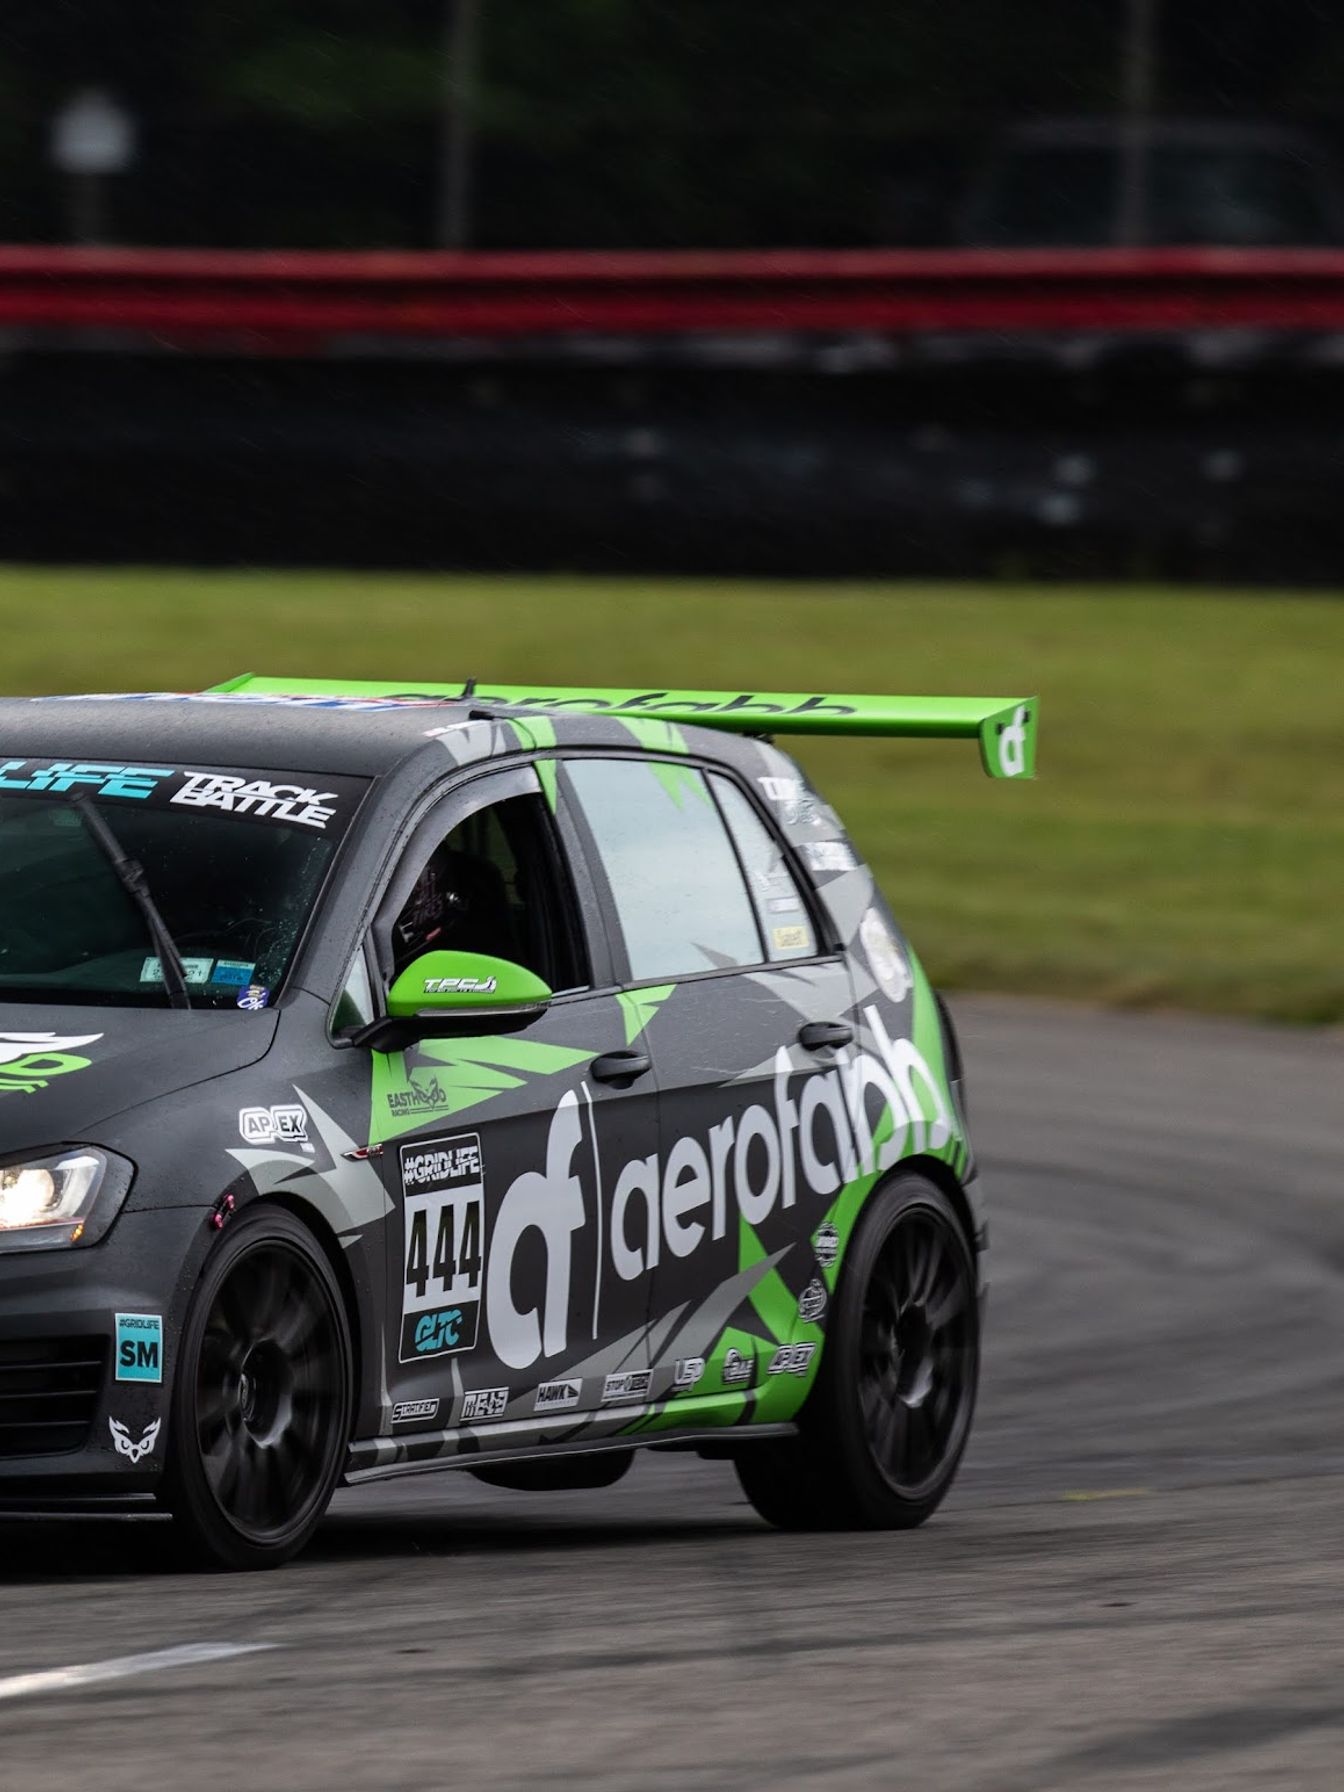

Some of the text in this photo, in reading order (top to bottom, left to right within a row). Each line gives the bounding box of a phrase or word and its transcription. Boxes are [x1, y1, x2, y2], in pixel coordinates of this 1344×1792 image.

[183, 771, 339, 806] TRACK
[169, 788, 337, 829] BATTLE
[610, 1004, 953, 1281] aerofabb
[404, 1145, 481, 1185] #GRIDLIFE
[406, 1200, 482, 1298] 444
[119, 1318, 160, 1329] #GRIDLIFE
[119, 1339, 158, 1368] SM
[537, 1384, 568, 1402] HAWK
